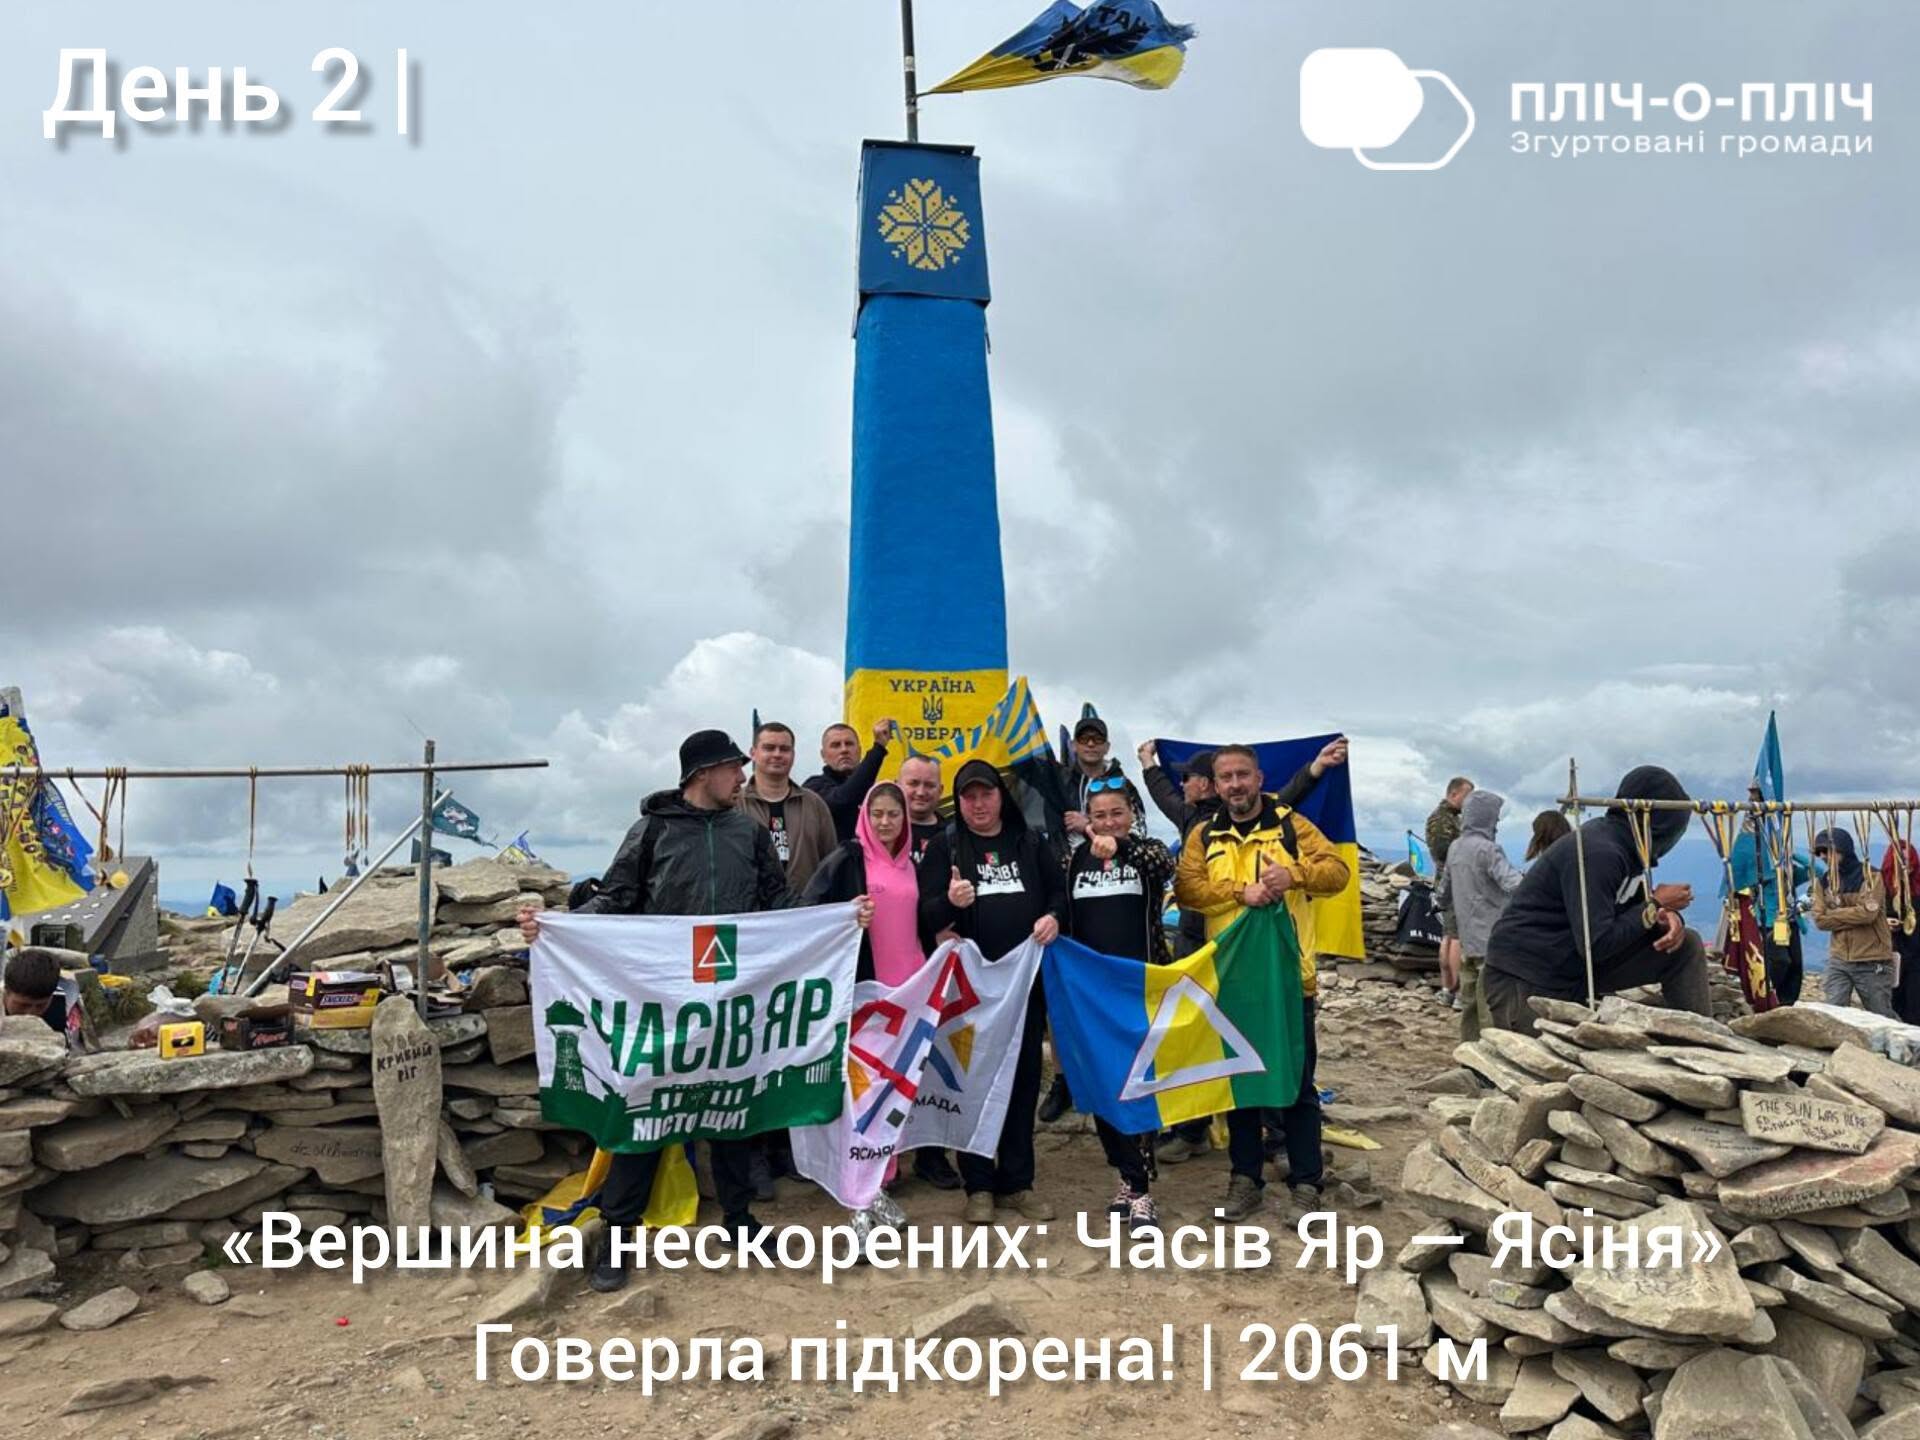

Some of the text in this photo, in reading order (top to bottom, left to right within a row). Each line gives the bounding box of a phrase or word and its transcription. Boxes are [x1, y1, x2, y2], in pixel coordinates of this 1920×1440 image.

[889, 677, 976, 693] УКРАЇНА
[590, 977, 833, 1078] ЧАСІВ ЯР
[911, 1095, 962, 1115] МАДА
[1755, 1099, 1867, 1128] THE SUN WAS HERE
[632, 1107, 748, 1142] МІСТО ЩИТ
